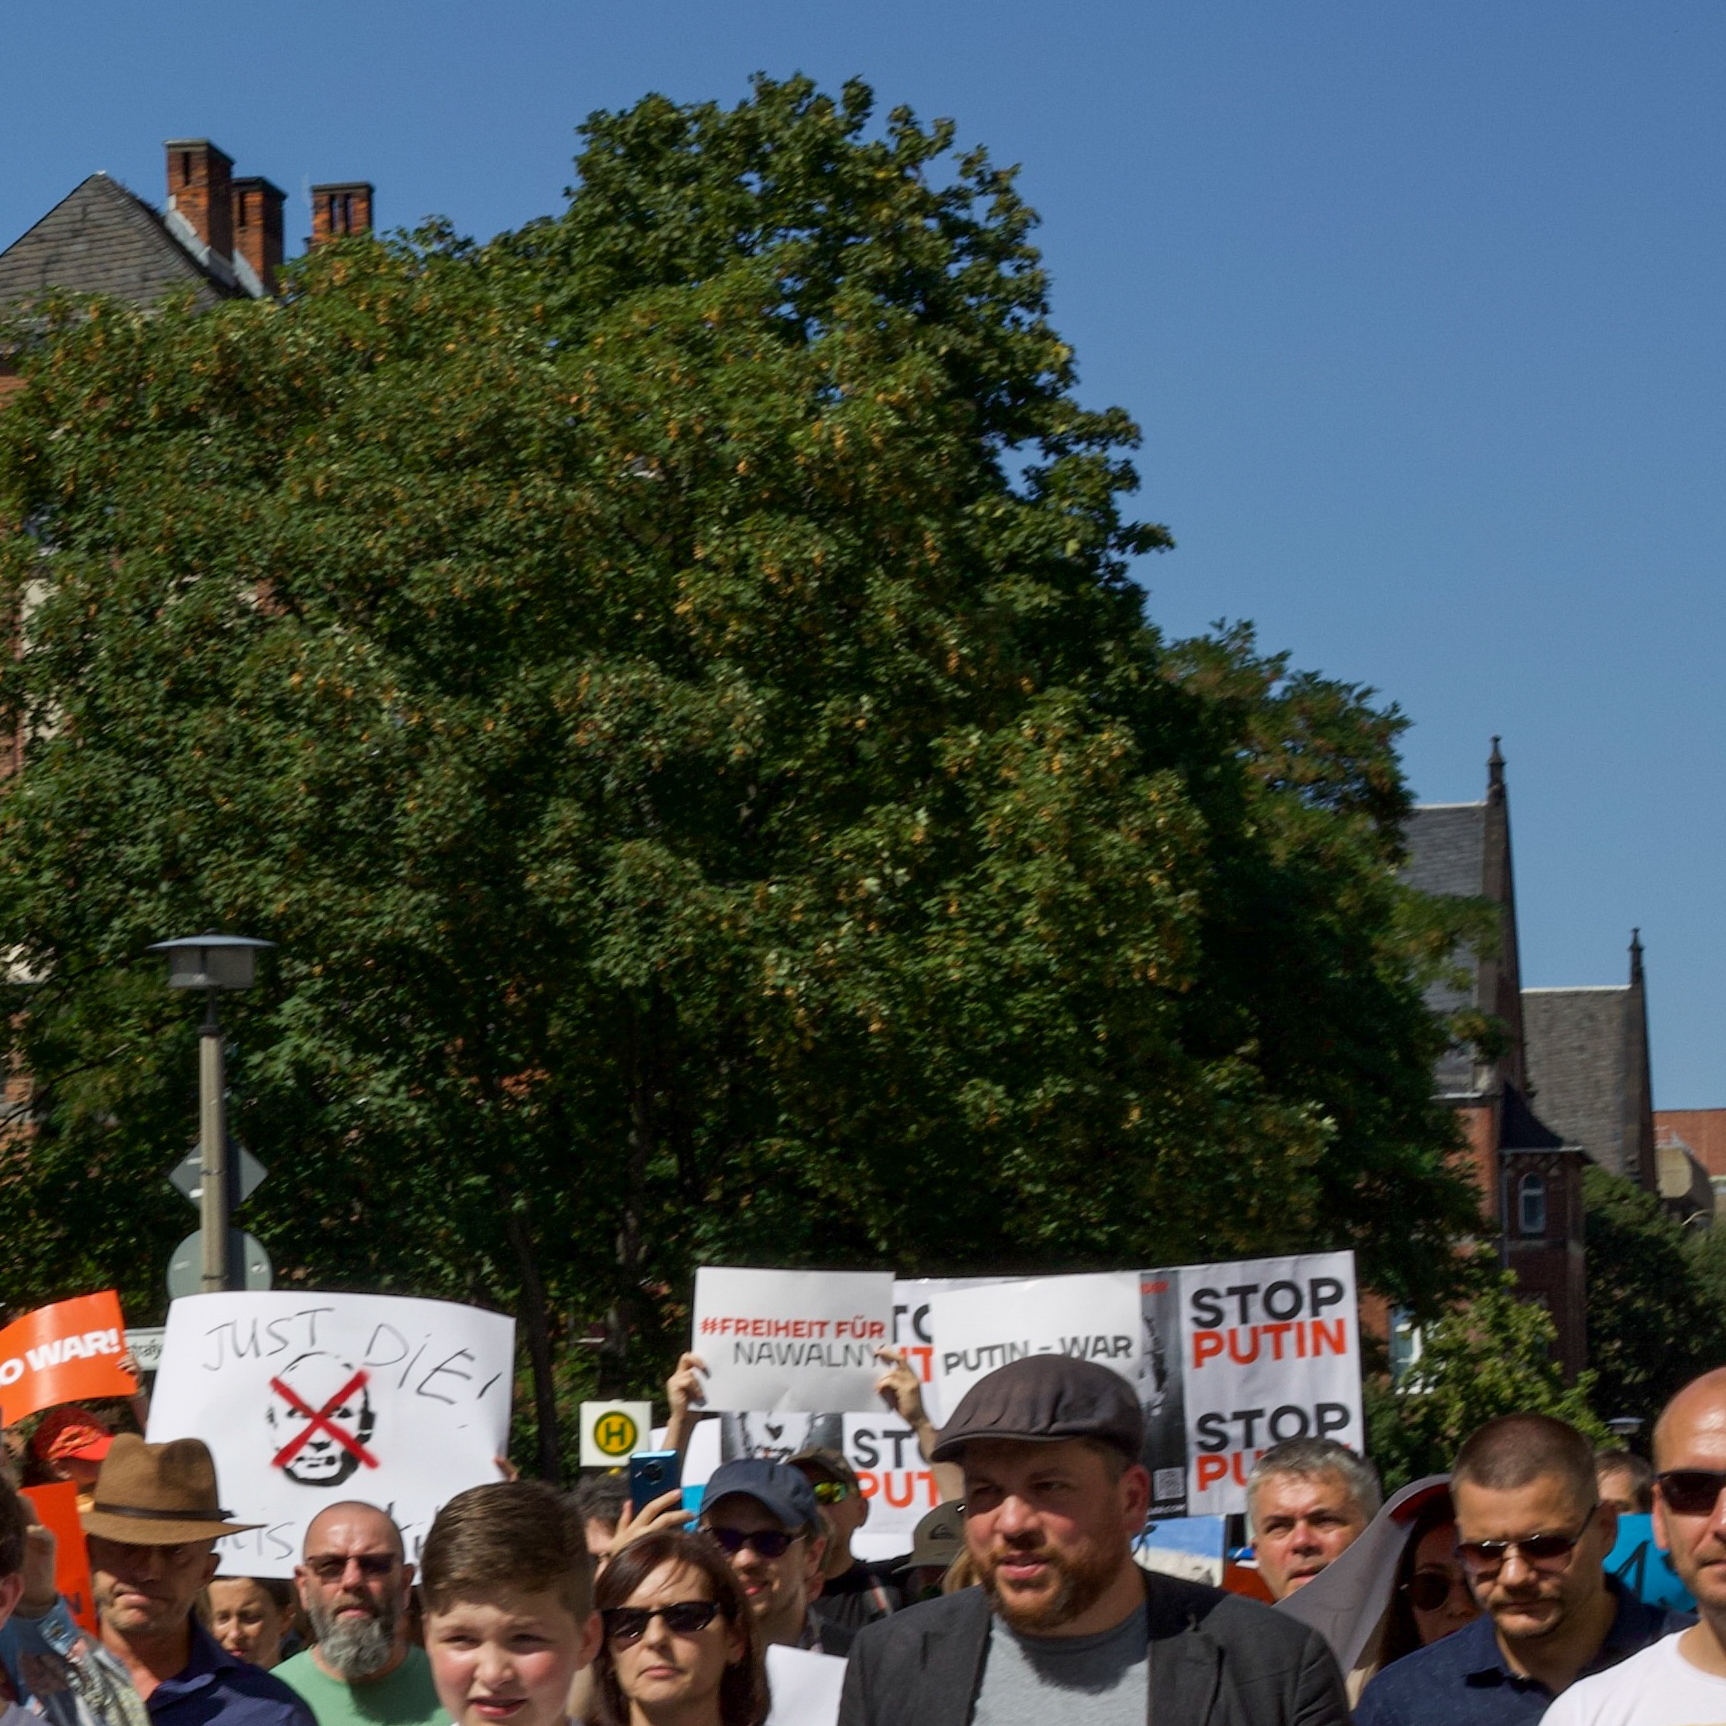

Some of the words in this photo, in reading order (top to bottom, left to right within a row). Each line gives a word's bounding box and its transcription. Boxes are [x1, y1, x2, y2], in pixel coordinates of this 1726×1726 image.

[1191, 1277, 1344, 1329] STOP
[202, 1307, 336, 1372] JUST
[700, 1316, 829, 1338] #FREIHEIT
[835, 1314, 886, 1339] FÜR
[1192, 1318, 1348, 1370] PUTIN
[25, 1327, 121, 1372] WAR!
[734, 1340, 886, 1368] NAWALNY
[944, 1340, 1029, 1376] PUTIN
[1060, 1335, 1133, 1362] WAR
[1196, 1402, 1351, 1452] STOP
[854, 1471, 941, 1508] PUT
